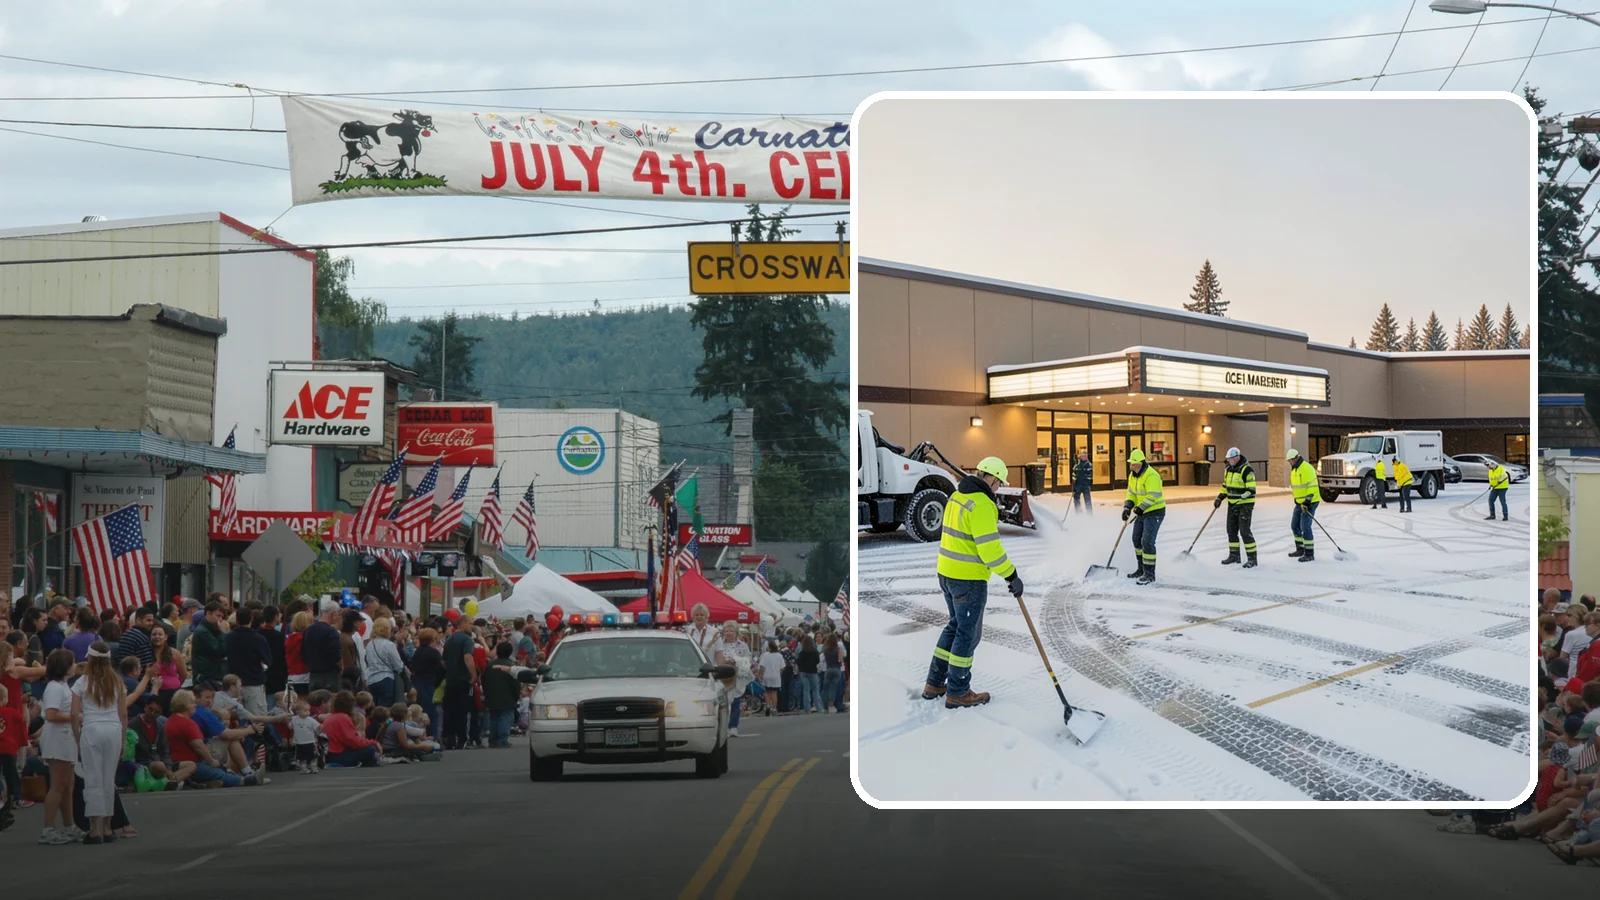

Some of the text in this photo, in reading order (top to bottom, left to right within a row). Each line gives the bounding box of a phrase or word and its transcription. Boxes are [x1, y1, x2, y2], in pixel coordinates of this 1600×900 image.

[481, 141, 605, 193] JULY
[632, 150, 746, 198] 4th.
[697, 254, 850, 280] CROSSWA
[283, 380, 373, 420] ACE
[406, 409, 485, 421] CEDAR LOG
[283, 421, 371, 436] Hardware
[416, 428, 476, 447] Coca-Cola
[96, 485, 124, 495] Vincent
[126, 486, 136, 495] de
[138, 486, 155, 495] Paul
[688, 526, 741, 535] CRNATION
[699, 535, 730, 543] GLASS
